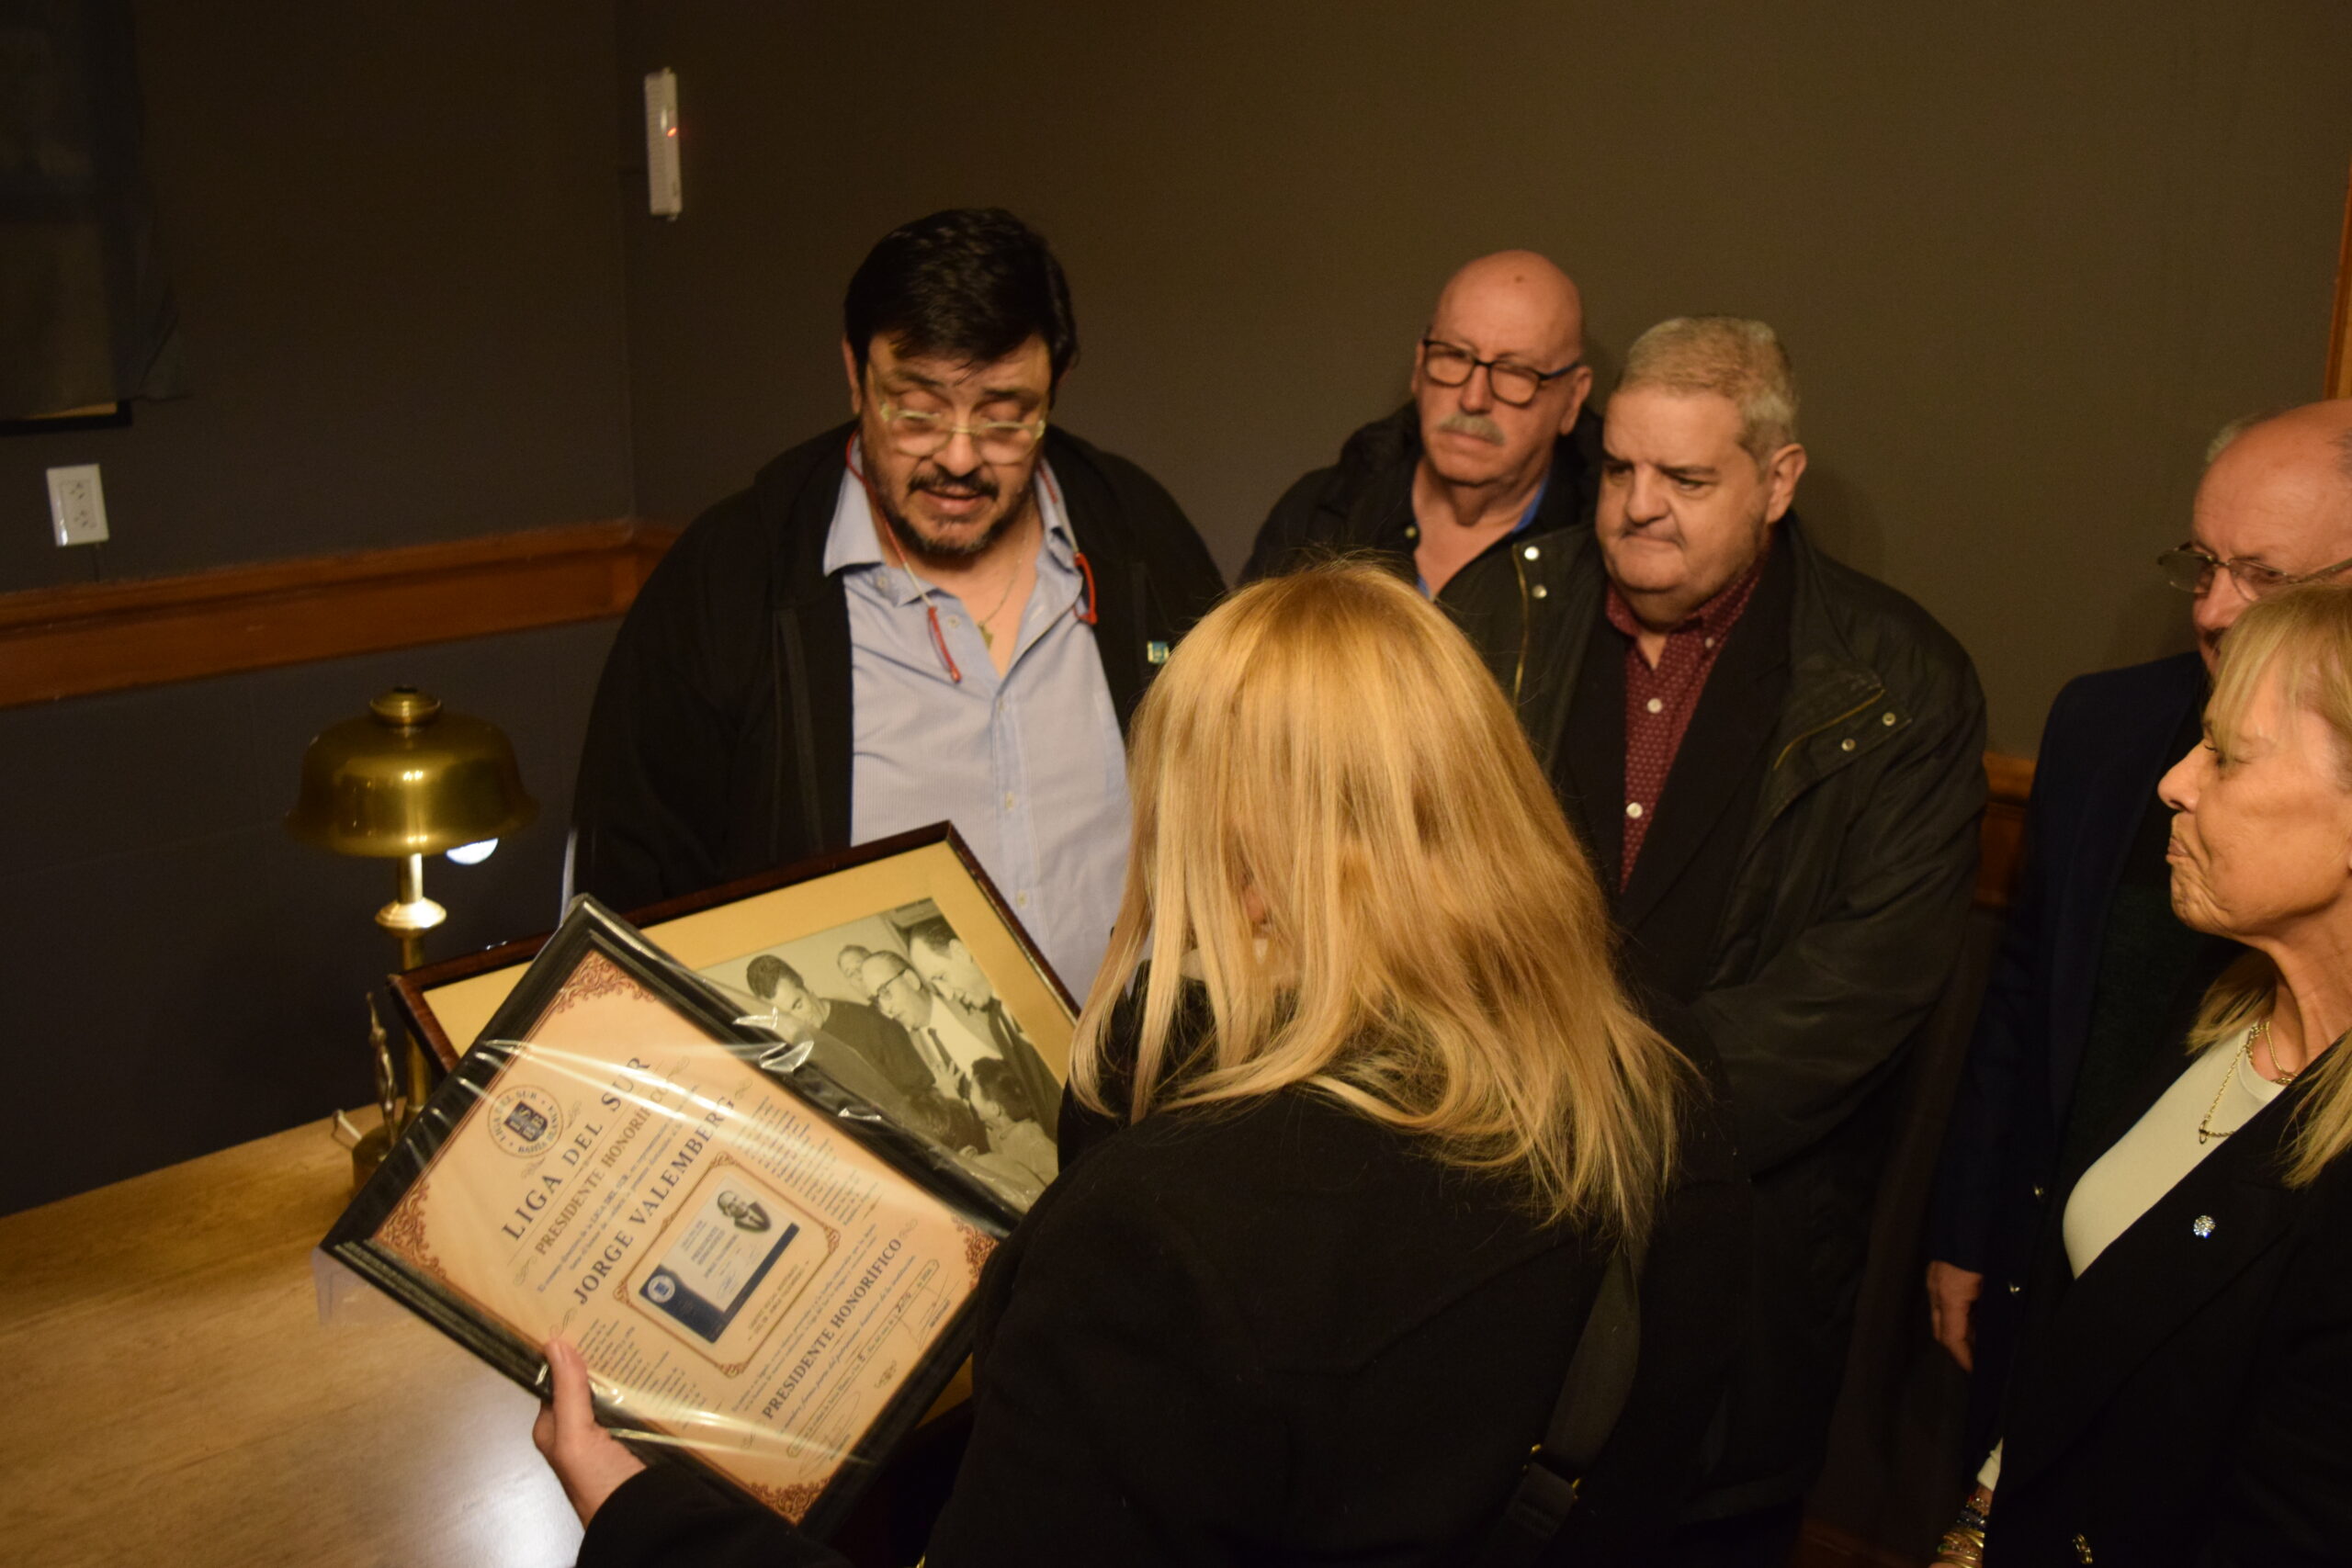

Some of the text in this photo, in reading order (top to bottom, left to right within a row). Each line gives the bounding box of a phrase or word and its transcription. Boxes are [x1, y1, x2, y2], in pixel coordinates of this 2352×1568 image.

[500, 1053, 650, 1242] LIGA DEL SUR
[533, 1079, 671, 1256] PRESIDENTE HONORÍFCO
[569, 1228, 634, 1305] JORGE
[760, 1326, 835, 1420] PRESIDENTE
[827, 1235, 904, 1329] HONORÍFICO
